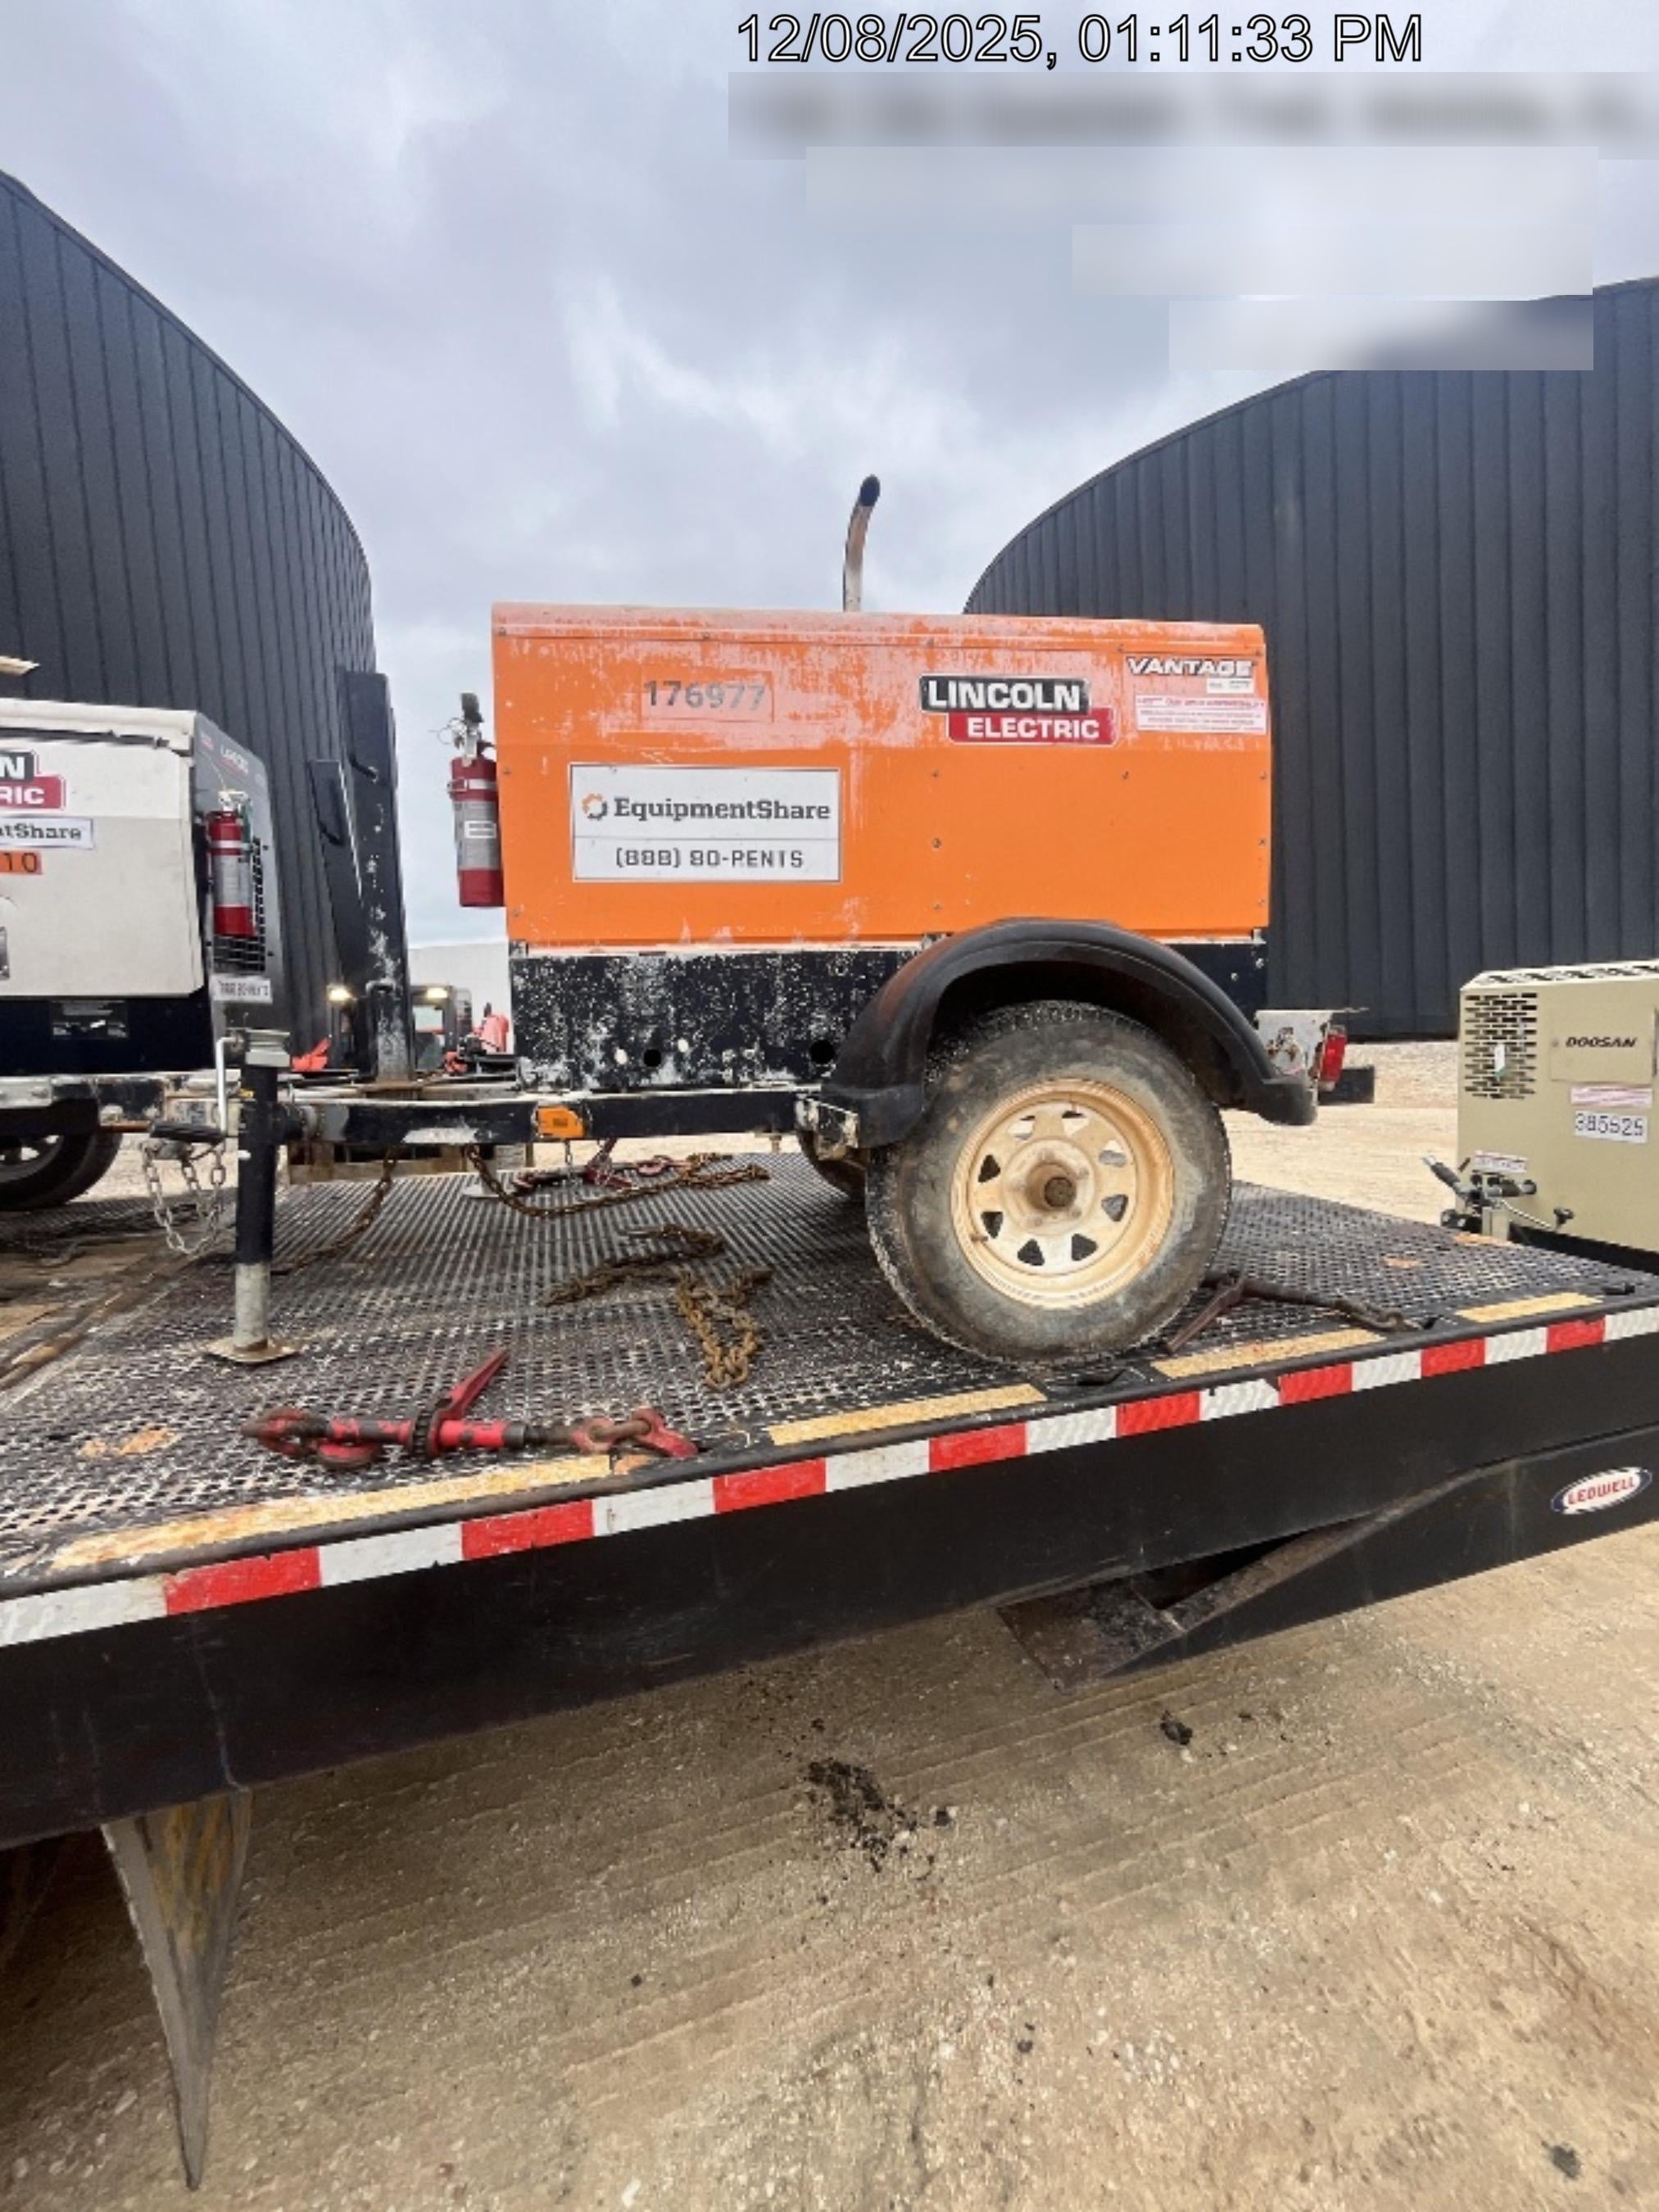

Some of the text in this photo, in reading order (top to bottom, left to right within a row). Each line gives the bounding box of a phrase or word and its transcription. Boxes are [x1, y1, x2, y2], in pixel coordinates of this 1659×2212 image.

[1127, 657, 1256, 678] VANTAGE
[644, 681, 765, 711] 176977
[927, 679, 1081, 711] LINCOLN
[967, 716, 1099, 739] ELECTRIC
[614, 796, 831, 821] EquipmentShare
[1566, 1036, 1637, 1048] DOOSAN
[1567, 1476, 1634, 1505] LEDWELL
